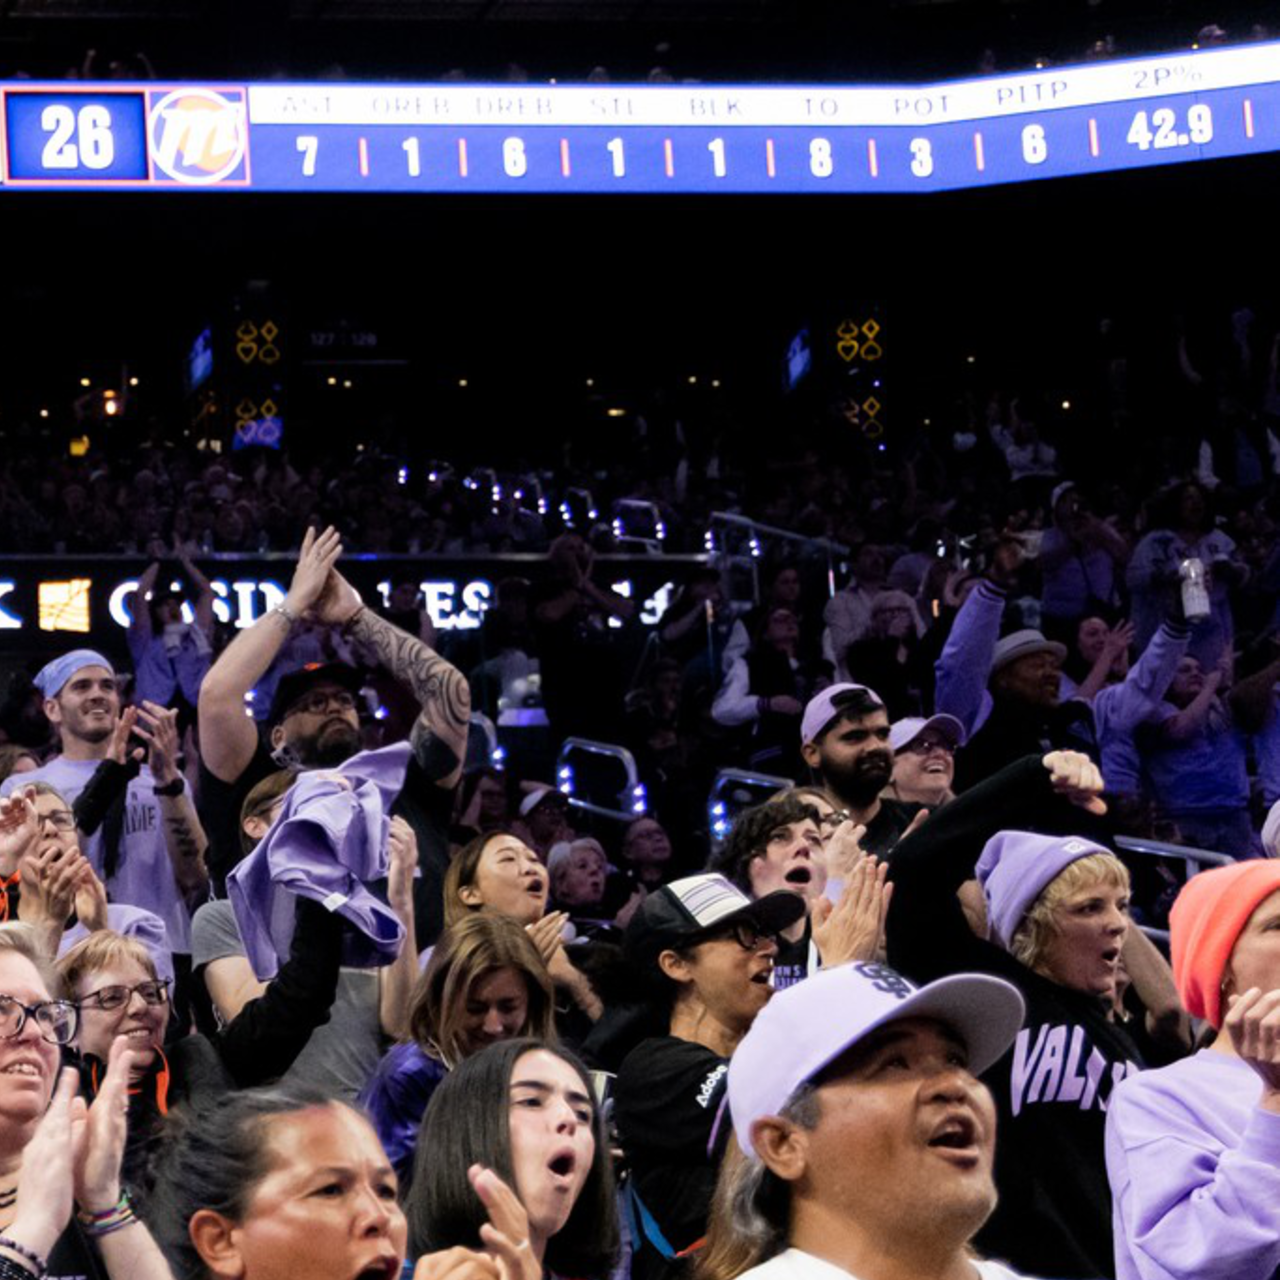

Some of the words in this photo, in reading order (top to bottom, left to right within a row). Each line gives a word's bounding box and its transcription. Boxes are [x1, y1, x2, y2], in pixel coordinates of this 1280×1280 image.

[996, 79, 1069, 105] PITP
[41, 105, 114, 169] 26
[296, 135, 318, 176] 7
[402, 136, 420, 177] 1
[503, 136, 527, 177] 6
[607, 137, 625, 177] 1
[708, 138, 726, 177] 1
[809, 137, 833, 177] 8
[910, 137, 933, 177] 3
[1021, 123, 1047, 164] 6
[1127, 103, 1213, 151] 42.9
